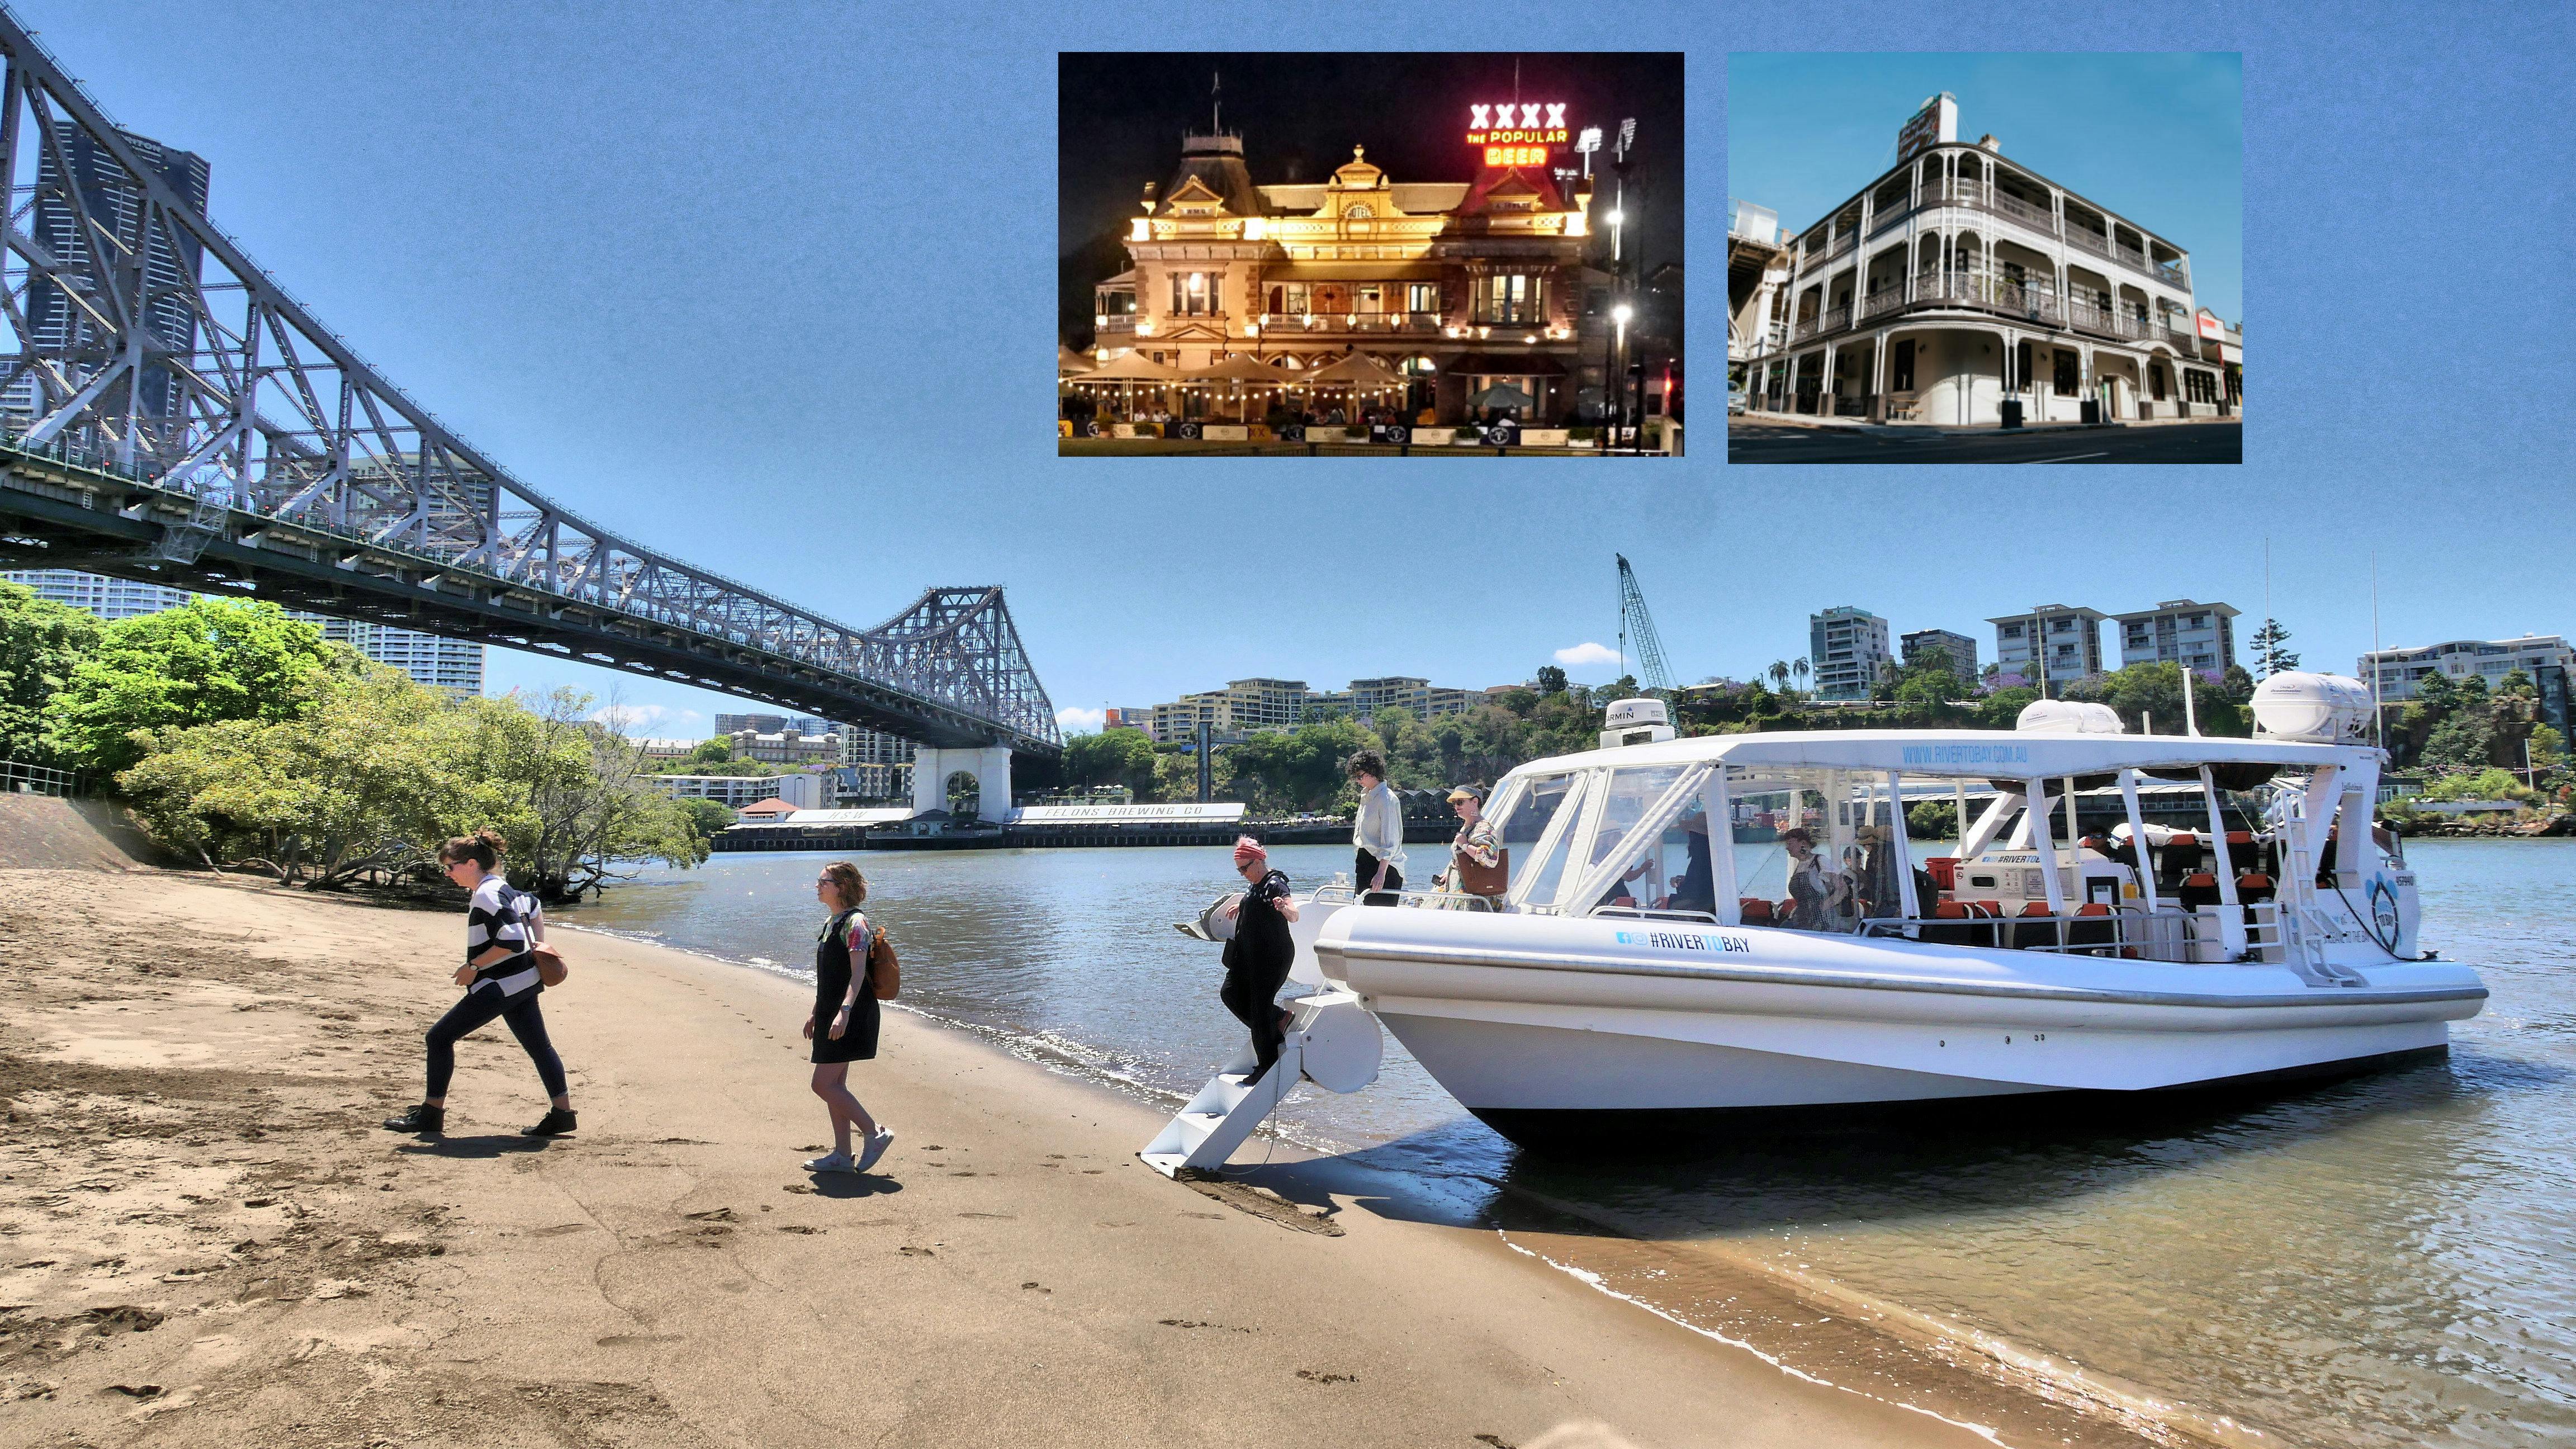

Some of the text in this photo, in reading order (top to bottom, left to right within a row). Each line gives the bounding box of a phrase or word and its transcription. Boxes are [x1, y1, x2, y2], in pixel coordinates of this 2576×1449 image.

[1470, 103, 1566, 130] XXXX
[1467, 131, 1568, 144] THE POPULAR
[1486, 147, 1547, 165] BEER
[1347, 206, 1370, 217] HOTEL
[1607, 712, 1634, 721] ARMIN
[1902, 745, 2027, 764] WWW.RIVERTOBAY.COM.AU
[1044, 806, 1202, 817] FELONS BREWING CO
[1650, 932, 1750, 953] #RIVERTOBAY
